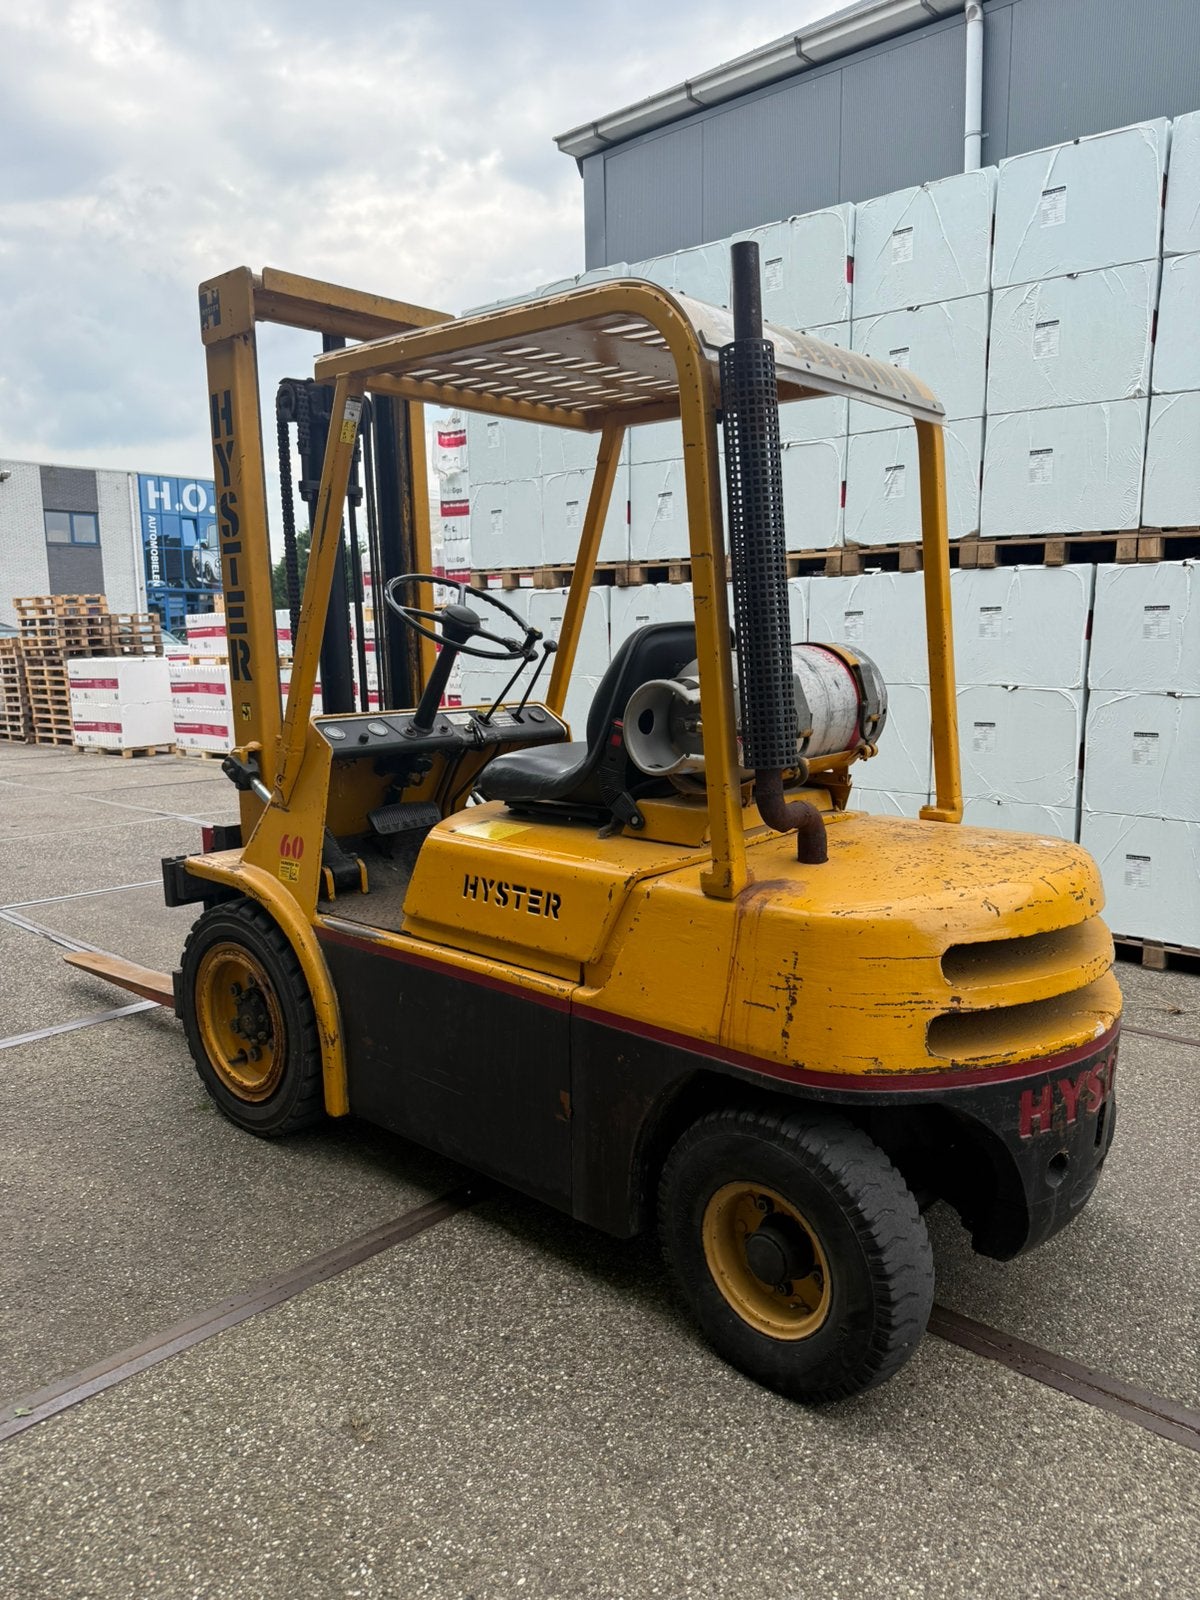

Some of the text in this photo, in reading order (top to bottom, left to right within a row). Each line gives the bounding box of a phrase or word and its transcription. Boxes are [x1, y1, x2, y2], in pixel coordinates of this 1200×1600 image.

[148, 515, 161, 588] AUTOMOBIELEN
[211, 389, 253, 681] HYSTER
[279, 833, 305, 860] 60
[462, 873, 562, 921] HYSTER
